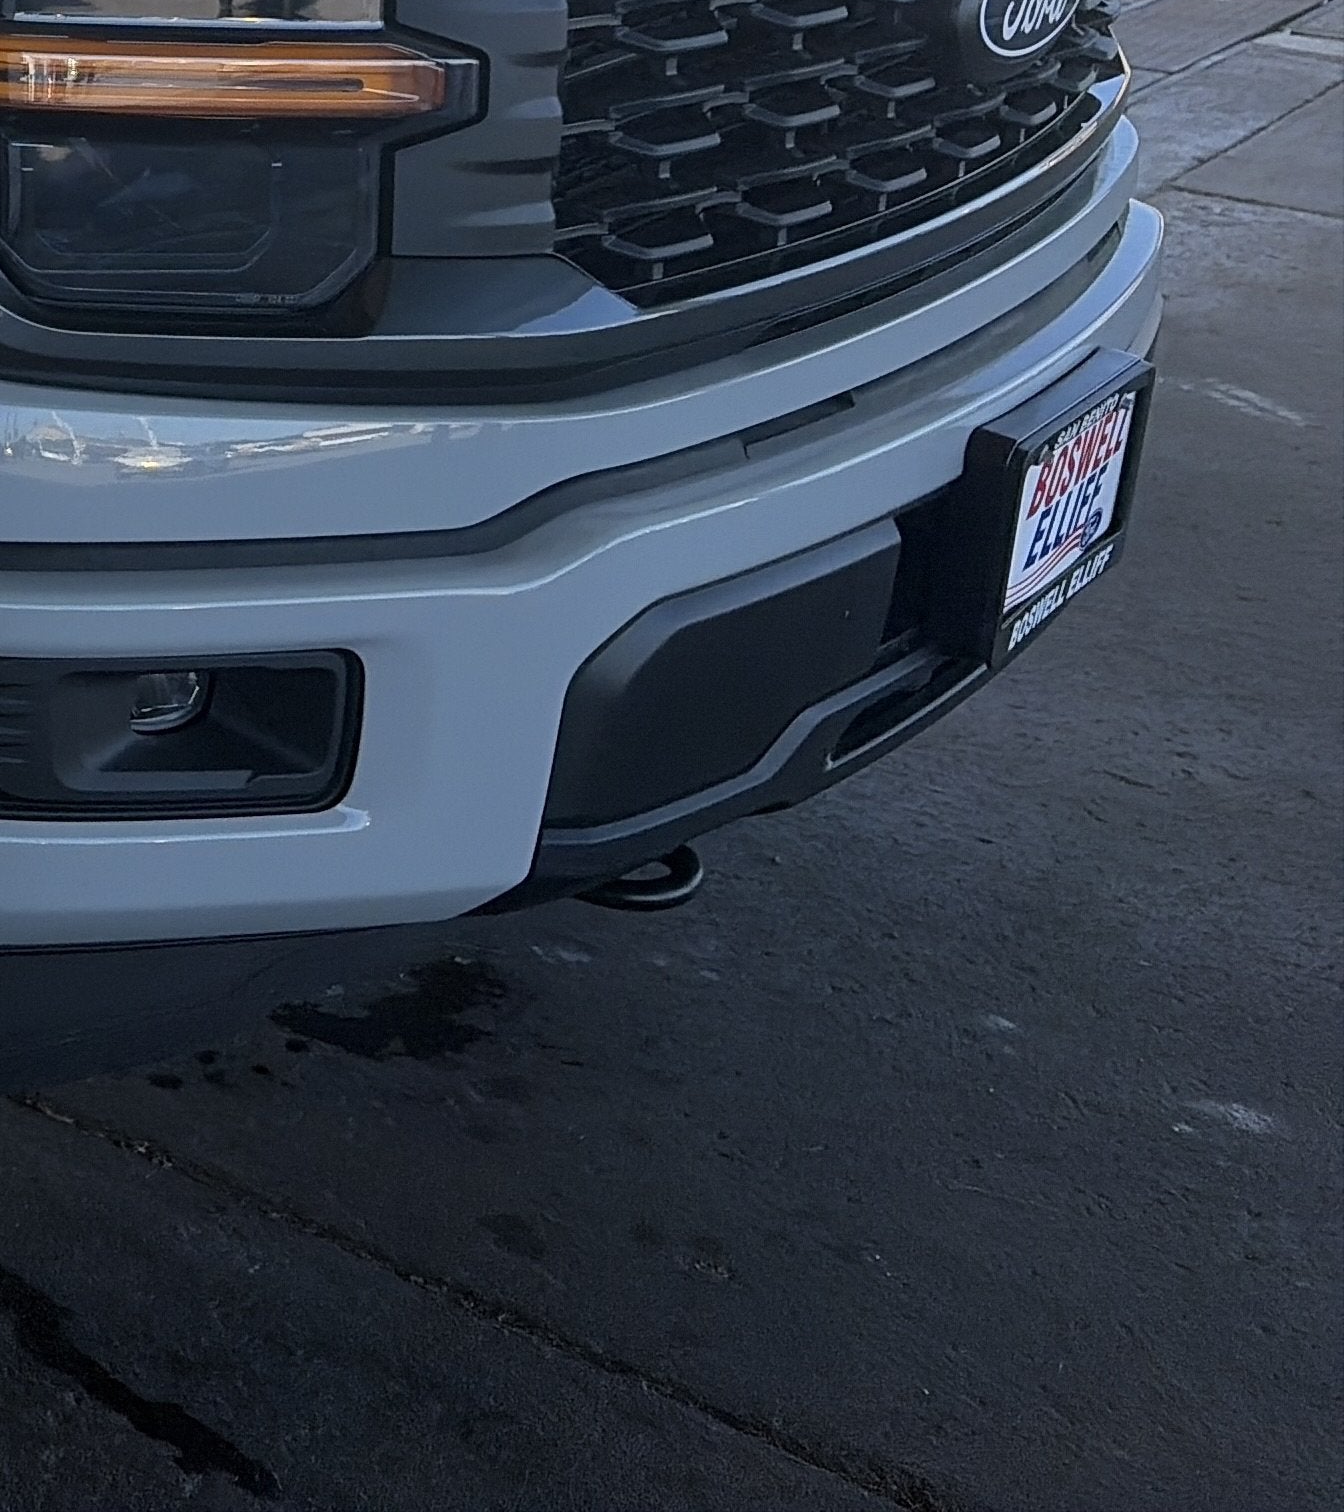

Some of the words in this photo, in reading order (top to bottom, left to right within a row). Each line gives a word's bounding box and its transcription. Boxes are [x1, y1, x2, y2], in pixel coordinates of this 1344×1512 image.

[1026, 408, 1129, 521] BOSWELL
[1054, 419, 1082, 450] SAN
[1078, 393, 1120, 434] BENITO
[1022, 462, 1110, 572] ELLIFF
[1007, 579, 1067, 651] BOSWELL
[1066, 543, 1114, 600] ELLIFF
